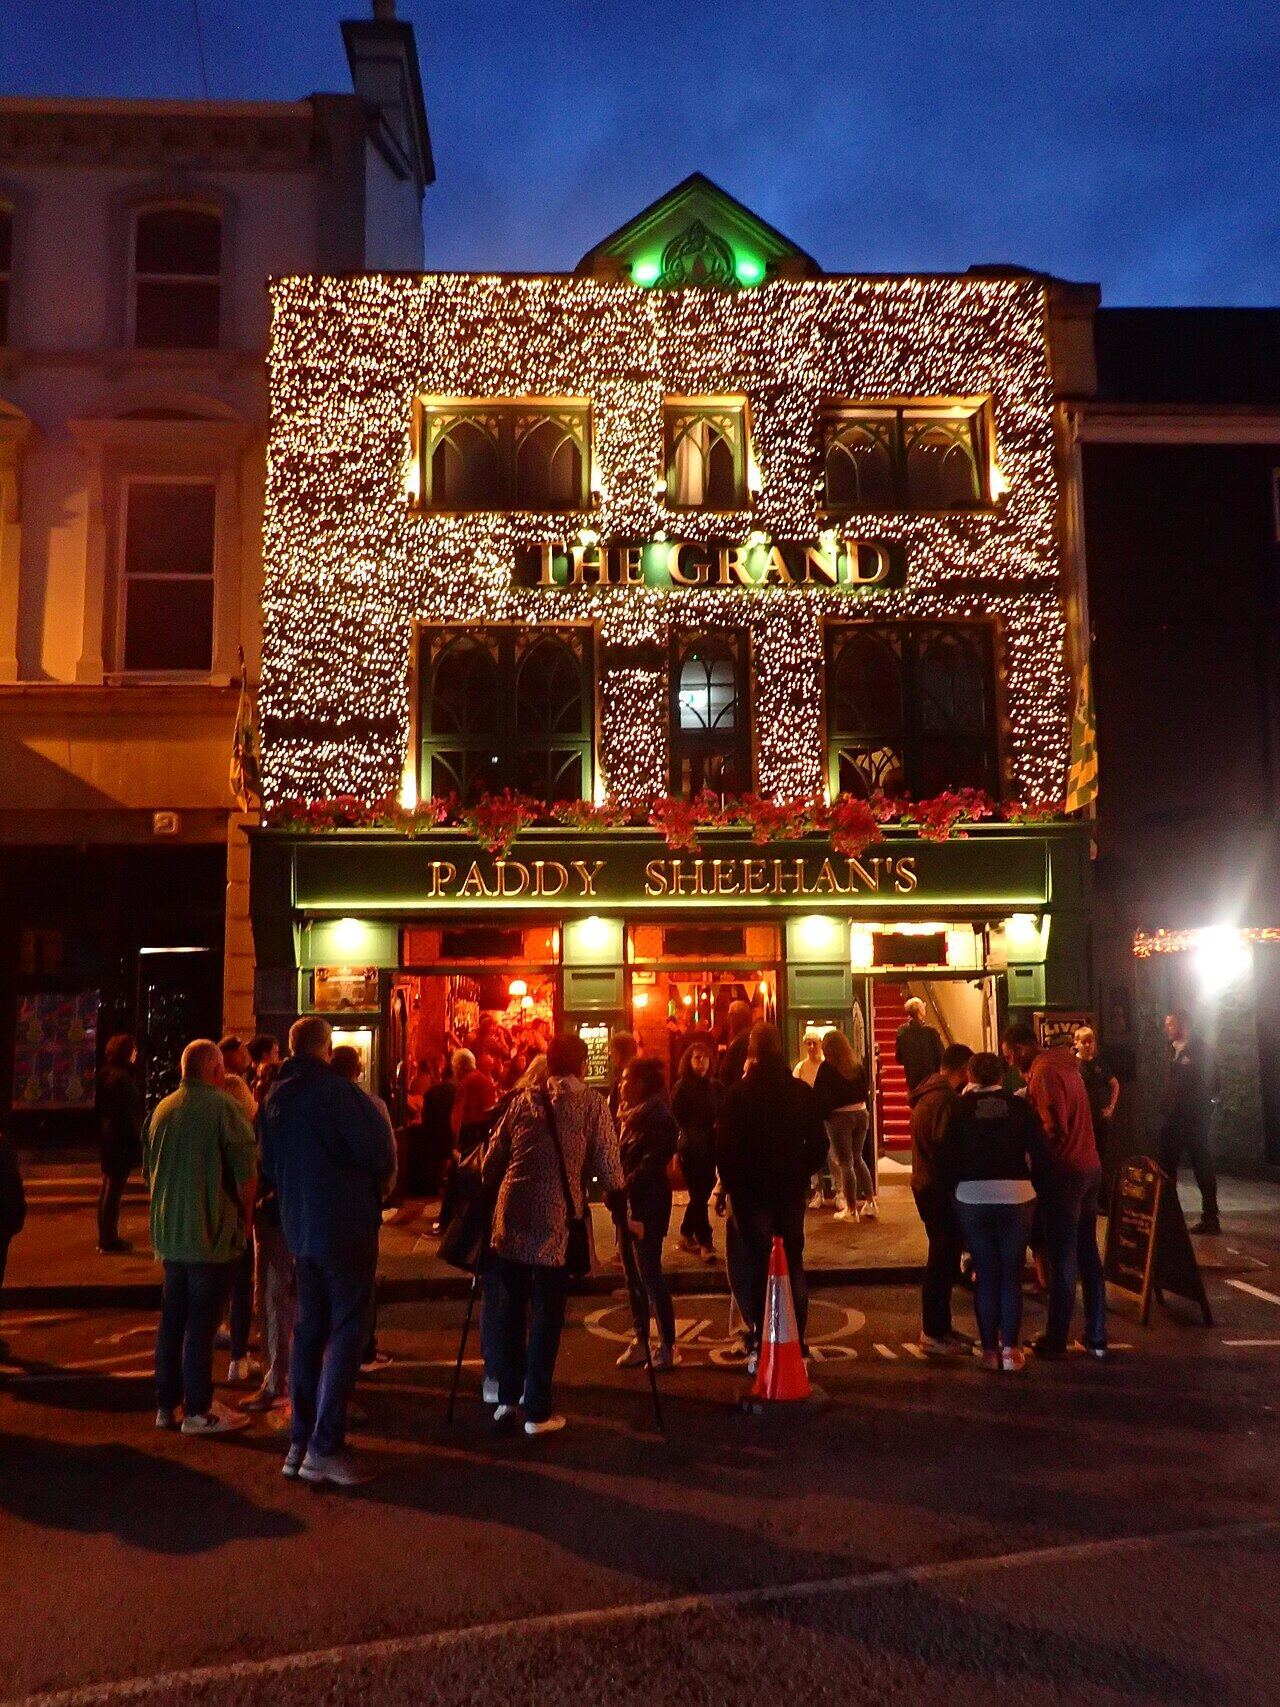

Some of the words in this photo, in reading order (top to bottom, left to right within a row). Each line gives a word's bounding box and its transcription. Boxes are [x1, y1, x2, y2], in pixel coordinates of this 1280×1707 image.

[528, 540, 645, 586] THE
[667, 540, 891, 585] GRAND
[427, 860, 607, 897] PADDY
[644, 857, 918, 896] SHEEHAN'S
